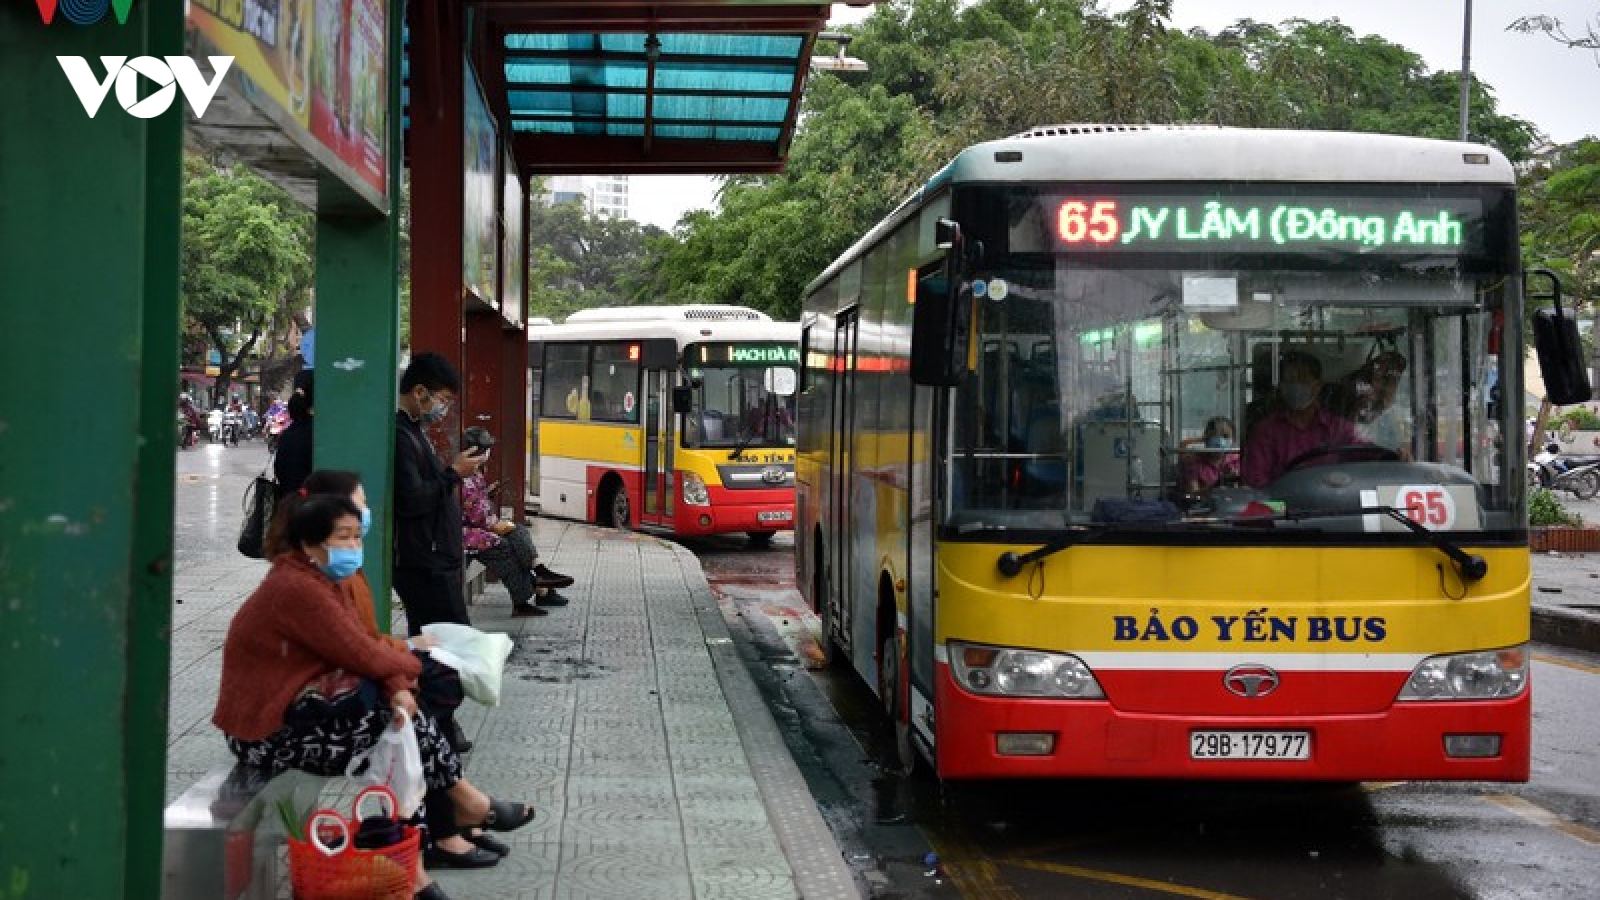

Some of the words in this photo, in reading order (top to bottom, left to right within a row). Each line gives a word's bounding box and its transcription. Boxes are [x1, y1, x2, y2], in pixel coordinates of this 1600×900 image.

[1058, 201, 1119, 243] 65
[1176, 200, 1260, 240] LÂM
[1269, 205, 1385, 247] (Đông
[1391, 210, 1462, 246] Anh
[1405, 490, 1447, 526] 65
[1113, 607, 1199, 641] BẢO
[1212, 607, 1298, 642] YẾN
[1307, 617, 1387, 642] BUS
[1193, 734, 1306, 757] 29B-179.77
